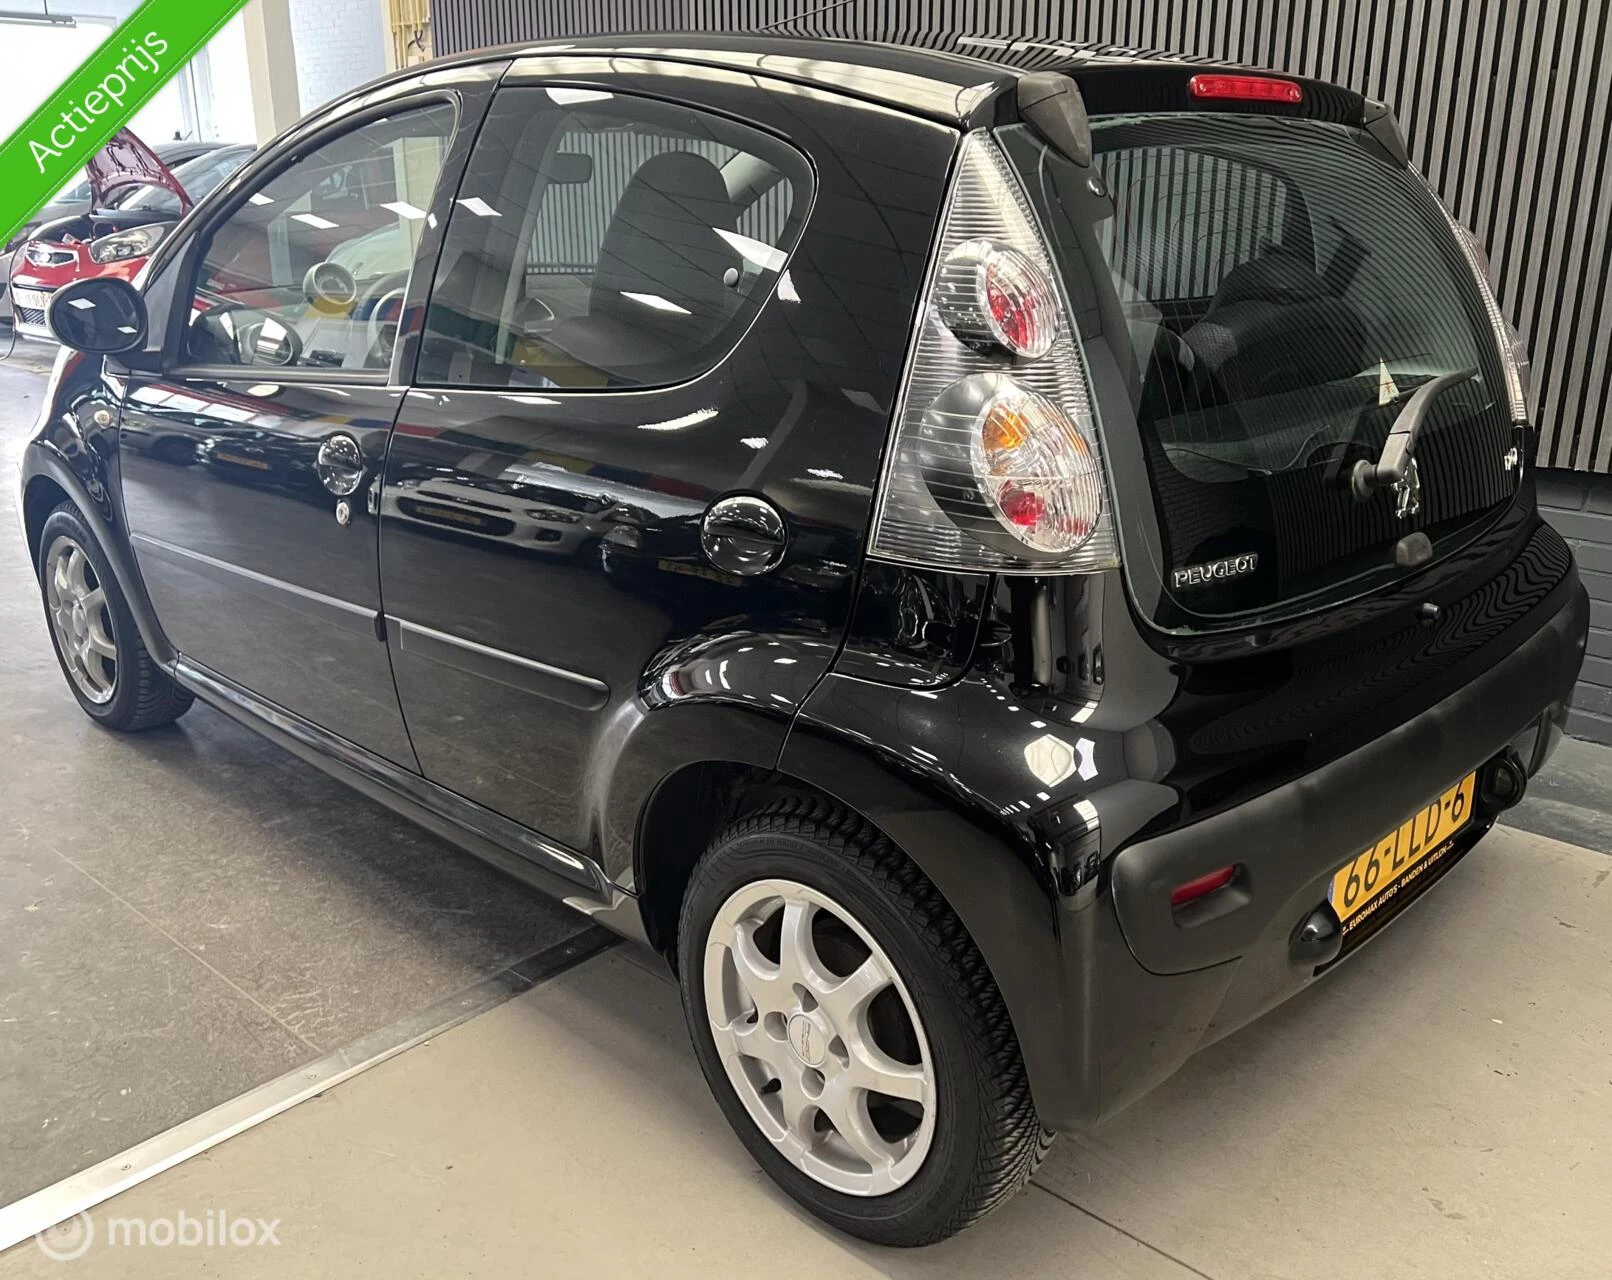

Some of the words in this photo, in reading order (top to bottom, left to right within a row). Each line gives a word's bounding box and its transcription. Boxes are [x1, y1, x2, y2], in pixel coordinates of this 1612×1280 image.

[1174, 553, 1258, 588] PEUGEOT
[1343, 780, 1465, 908] 66-LLD-6
[1349, 900, 1378, 930] EUROMAX
